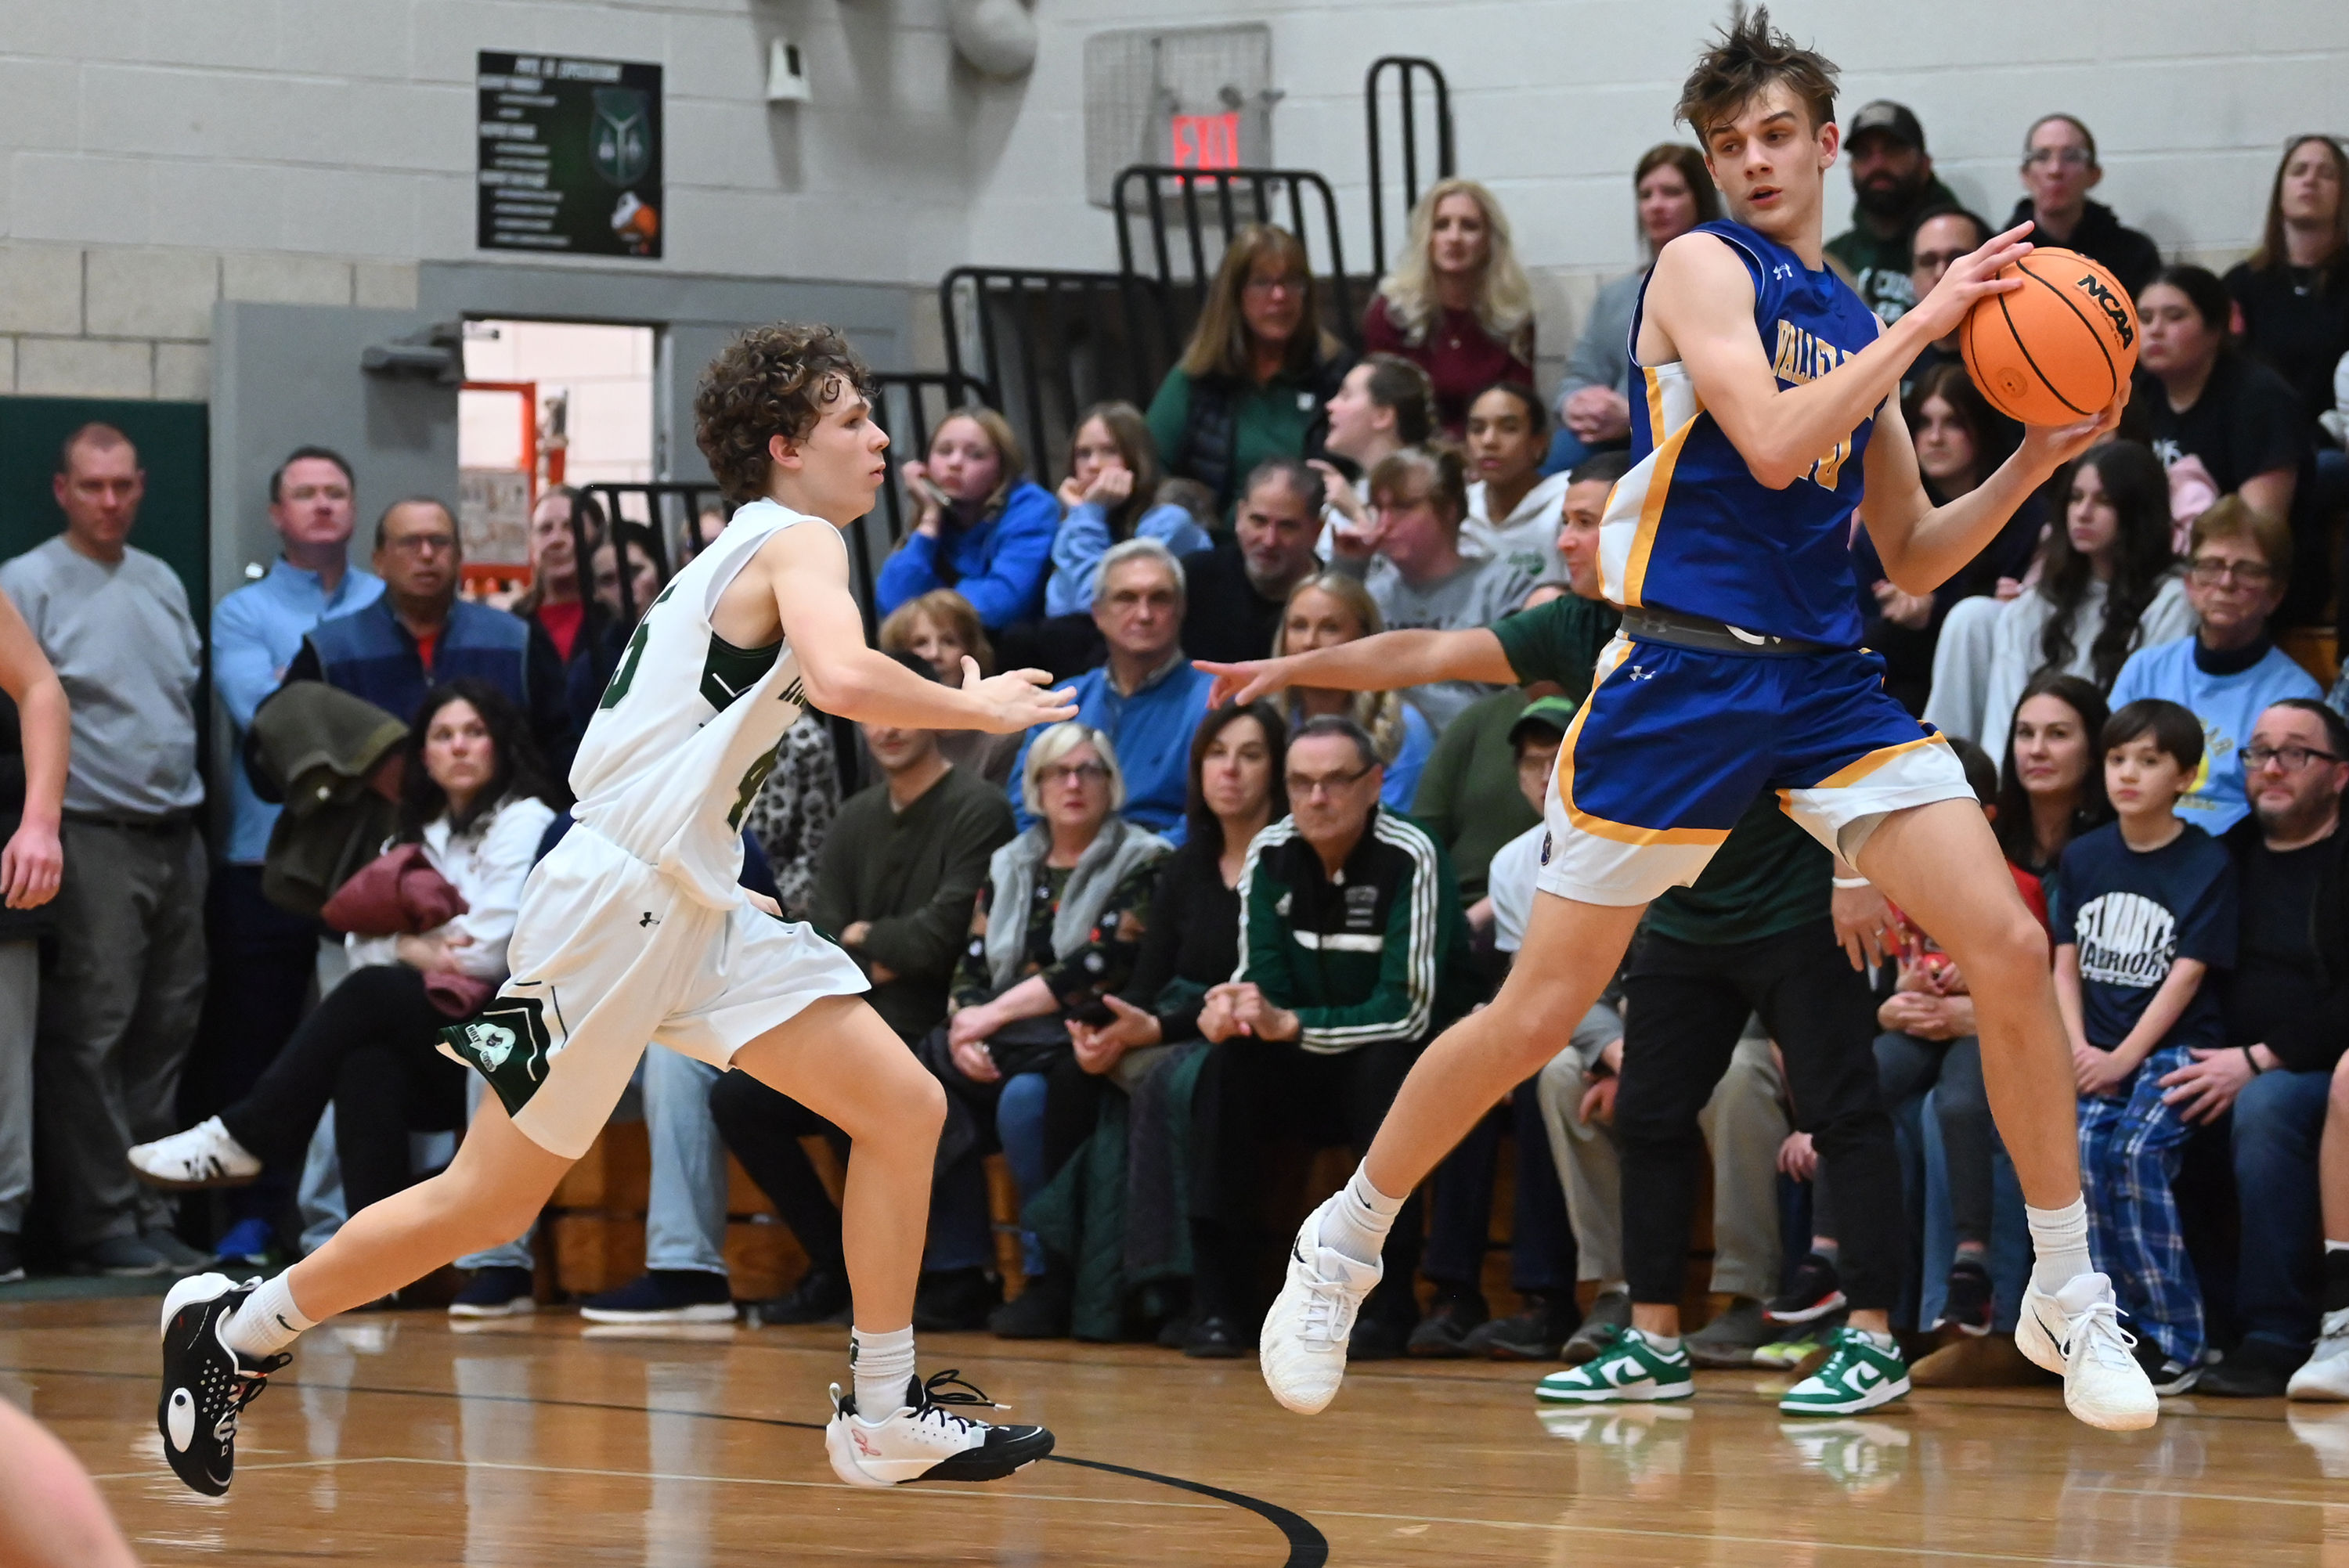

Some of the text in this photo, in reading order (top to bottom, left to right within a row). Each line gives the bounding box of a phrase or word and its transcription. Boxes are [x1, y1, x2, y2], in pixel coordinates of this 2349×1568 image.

[1172, 111, 1239, 185] EXIT
[2077, 274, 2134, 350] NCAA
[1773, 319, 1837, 385] VALLEY
[467, 1025, 482, 1044] HOLY
